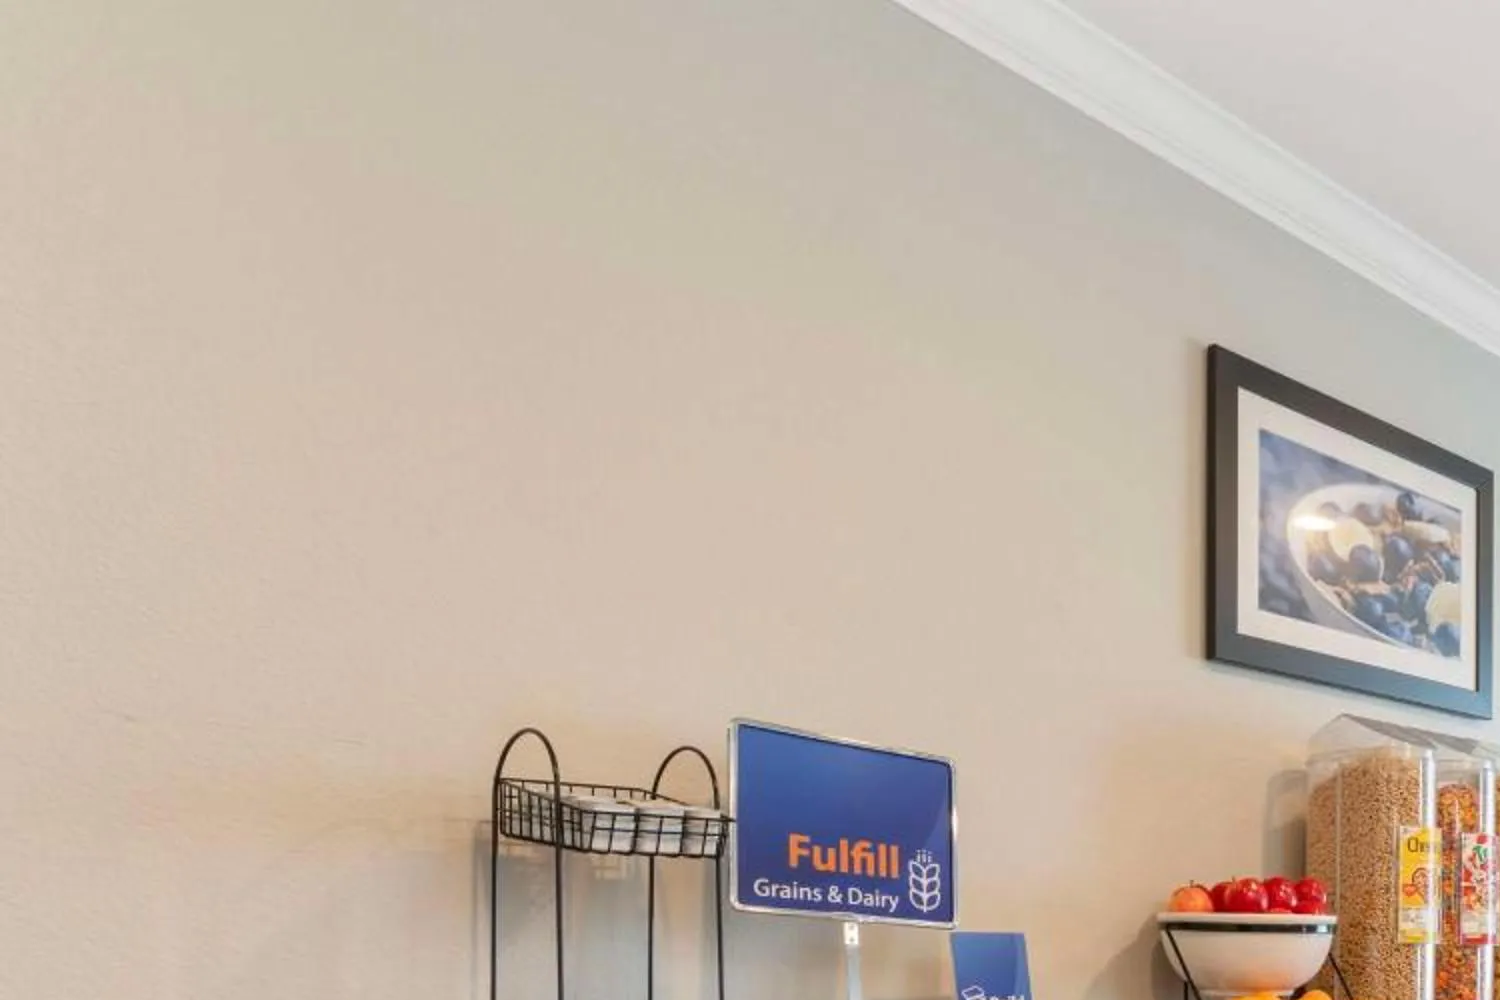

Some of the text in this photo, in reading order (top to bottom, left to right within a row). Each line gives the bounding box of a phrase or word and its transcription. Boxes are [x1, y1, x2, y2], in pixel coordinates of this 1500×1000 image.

[788, 832, 899, 879] Fulfill
[753, 877, 899, 913] Grains & Dairy
